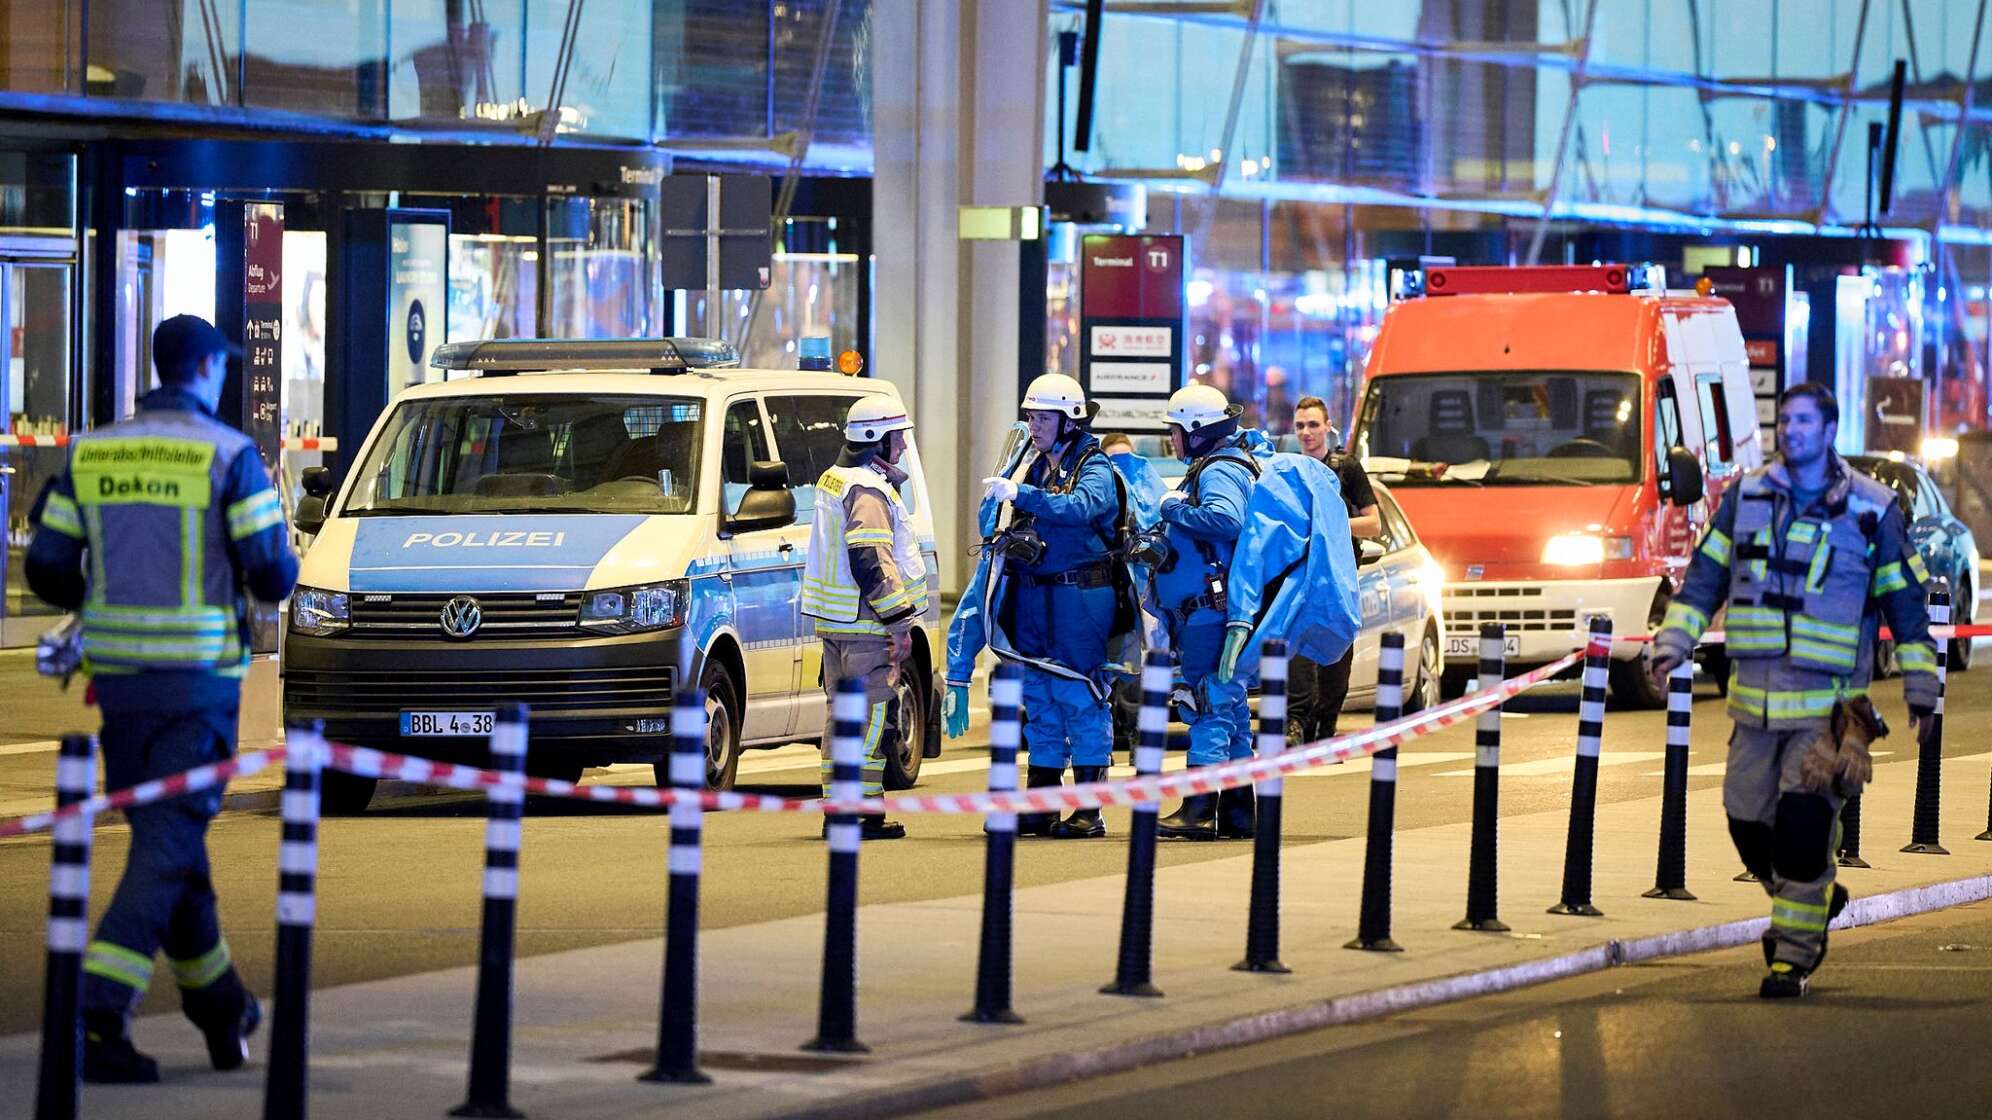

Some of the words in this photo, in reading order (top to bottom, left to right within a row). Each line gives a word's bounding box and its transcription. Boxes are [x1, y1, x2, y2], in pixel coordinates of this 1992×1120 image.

[250, 222, 259, 240] T1
[1093, 256, 1134, 268] Terminal
[1148, 251, 1168, 268] T1
[402, 531, 567, 549] POLIZEI
[411, 715, 443, 733] BBL
[450, 715, 460, 733] 4
